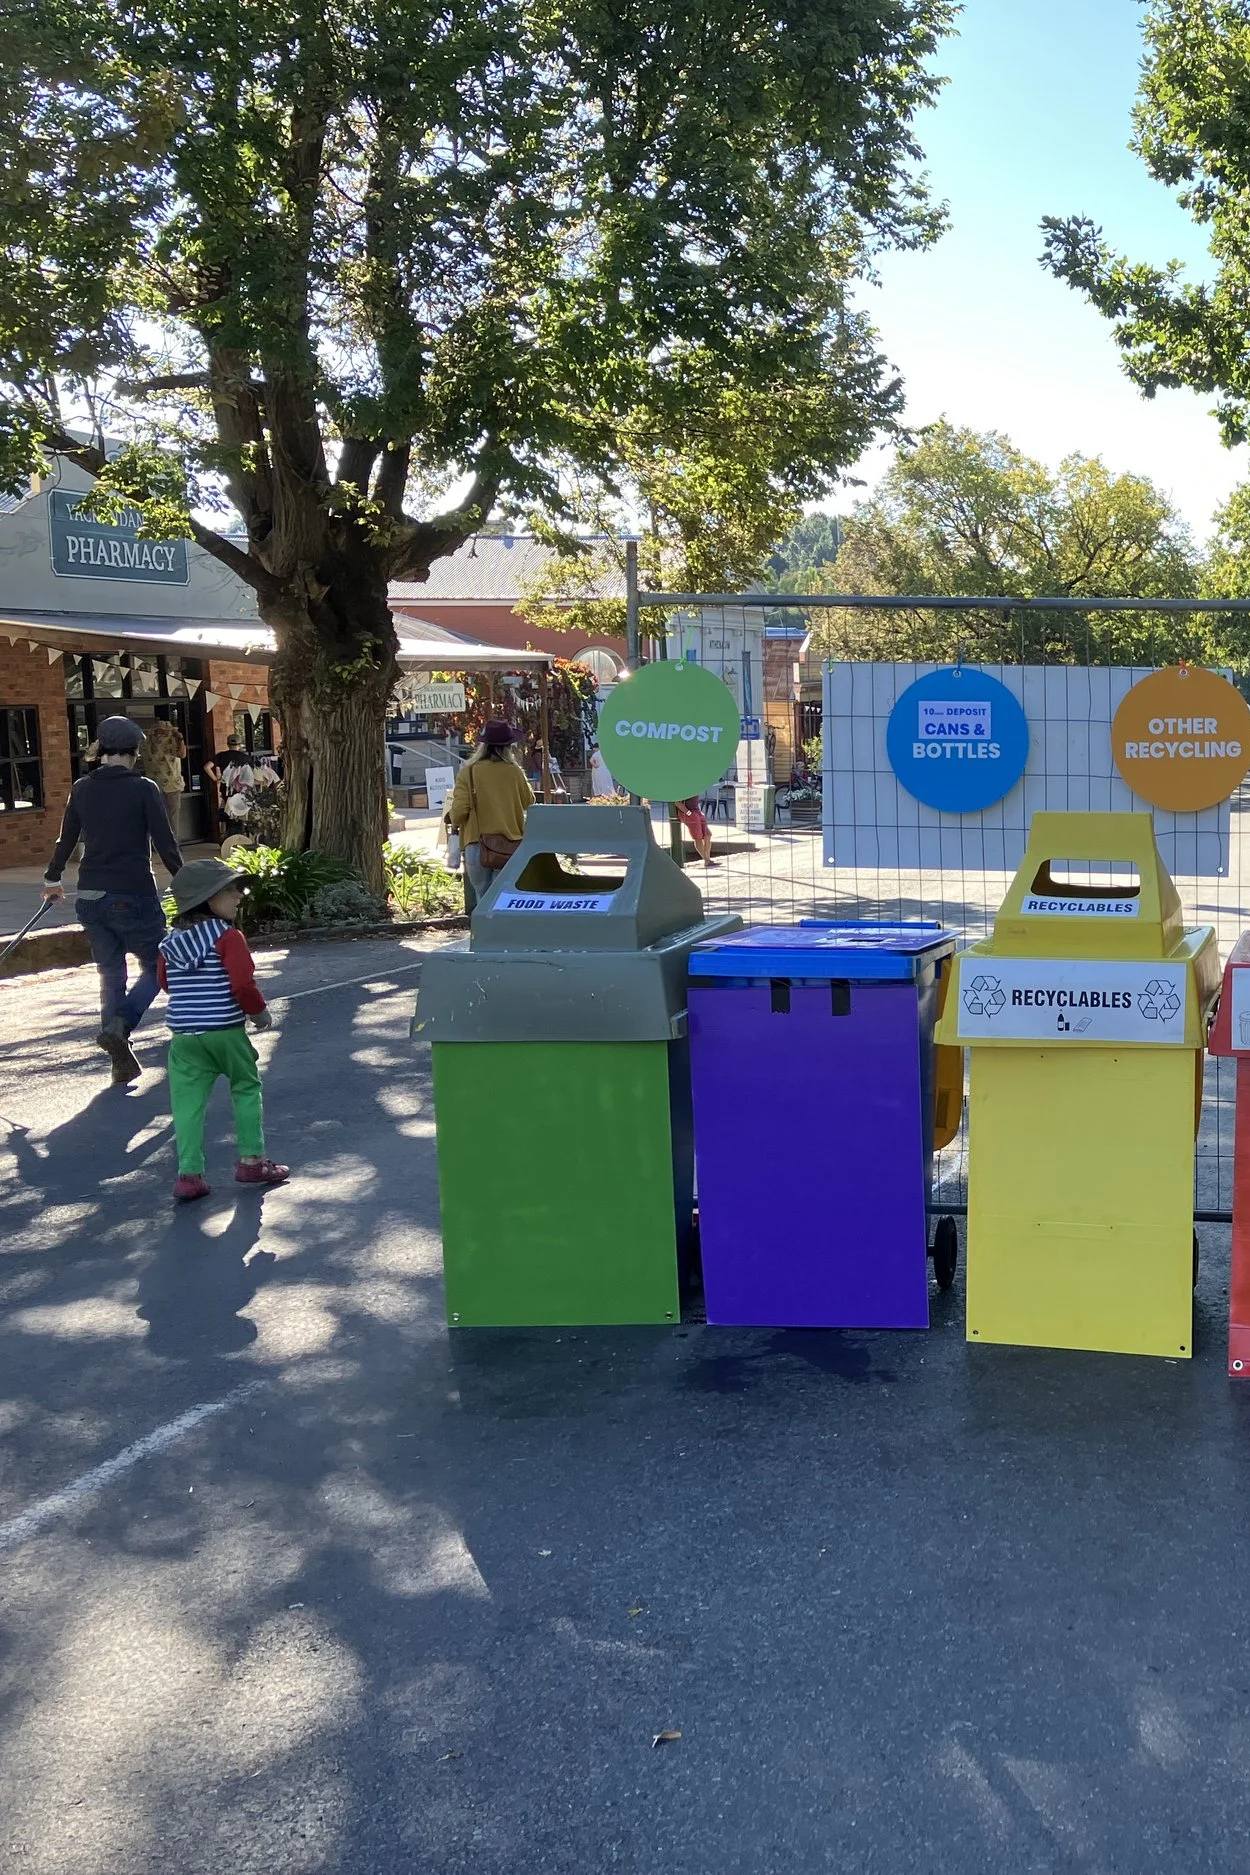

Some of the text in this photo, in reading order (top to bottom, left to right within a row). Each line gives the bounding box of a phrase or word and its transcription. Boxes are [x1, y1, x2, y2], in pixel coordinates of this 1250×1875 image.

[66, 535, 176, 572] PHARMACY
[415, 693, 463, 709] PHARMACY
[946, 708, 987, 716] DEPOSIT
[615, 720, 723, 743] COMPOST
[925, 723, 985, 735] CANS &
[1148, 718, 1218, 735] OTHER
[912, 742, 1001, 759] BOTTLES
[1125, 741, 1241, 758] RECYCLING
[507, 899, 599, 910] FOOD WASTE
[1027, 900, 1133, 913] RECYCLABLES
[1012, 989, 1132, 1009] RECYCLABLES
